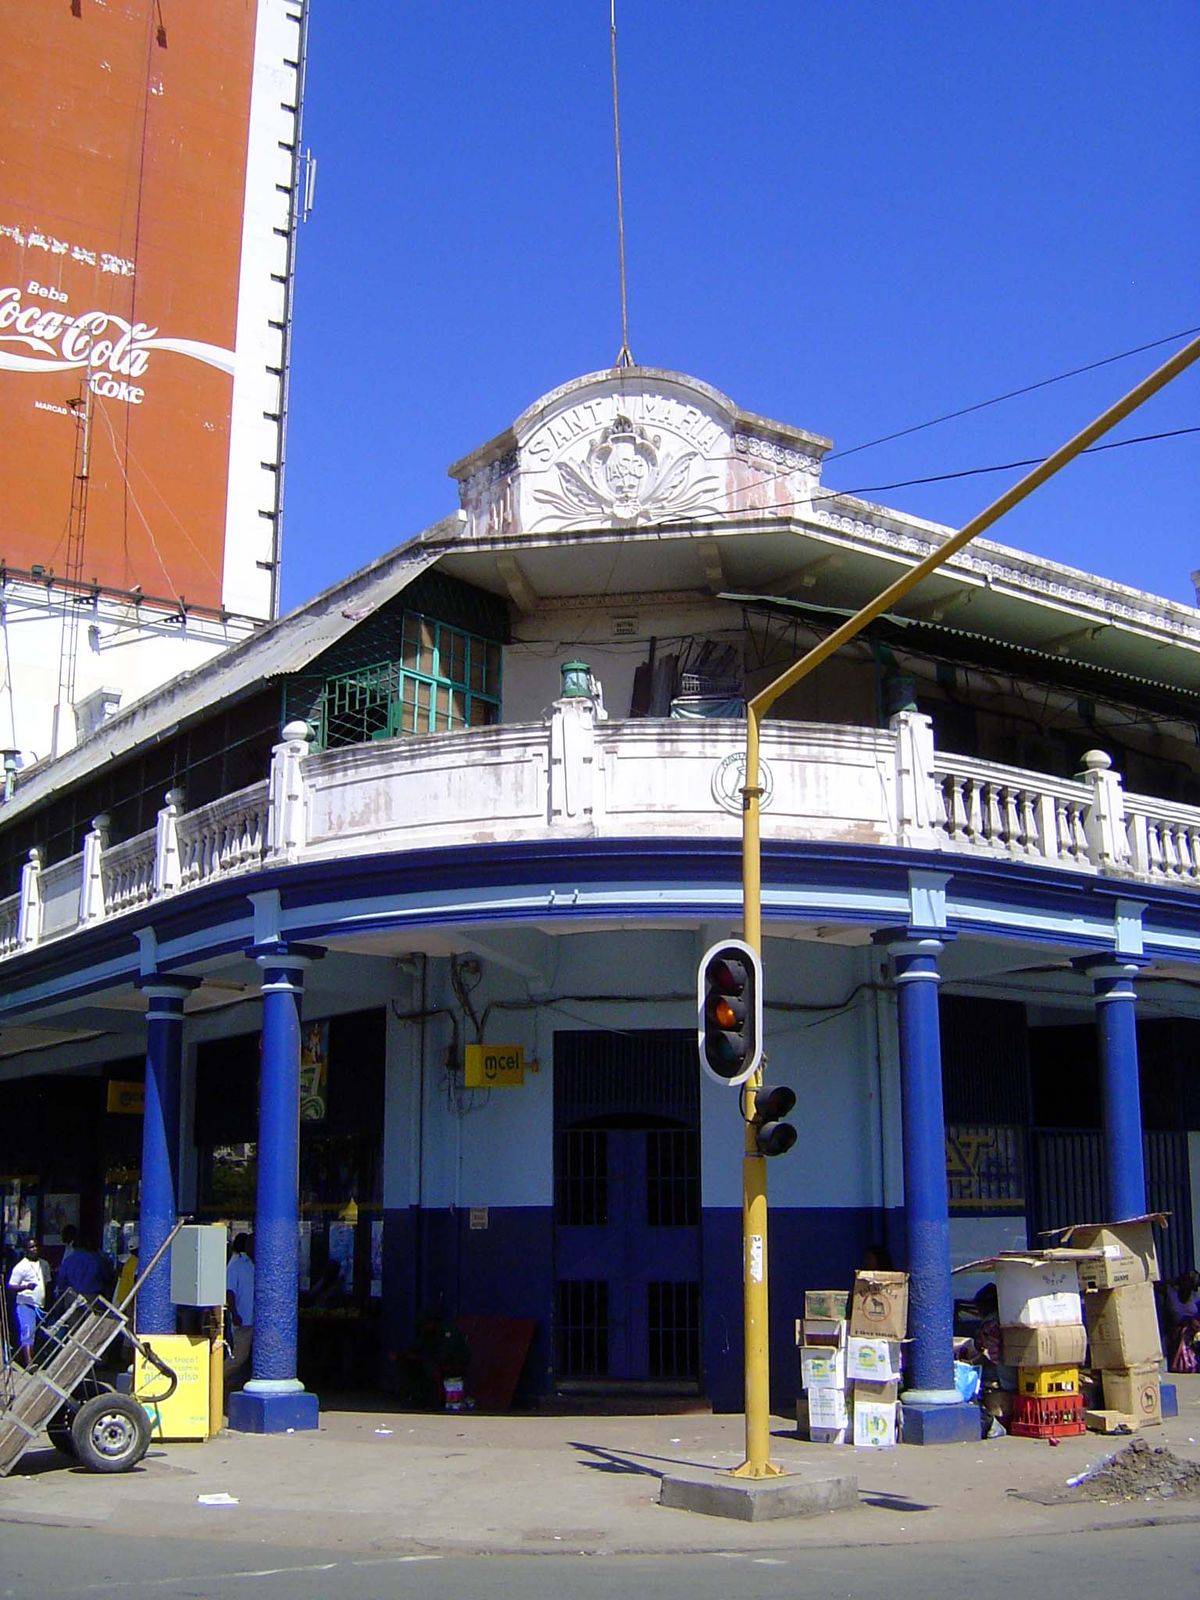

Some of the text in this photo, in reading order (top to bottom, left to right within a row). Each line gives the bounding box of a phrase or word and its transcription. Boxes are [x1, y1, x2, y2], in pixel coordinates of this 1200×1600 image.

[27, 281, 68, 303] Beba
[90, 372, 145, 404] Coke
[528, 393, 725, 463] SANTA MARIA
[485, 1051, 519, 1071] mcel
